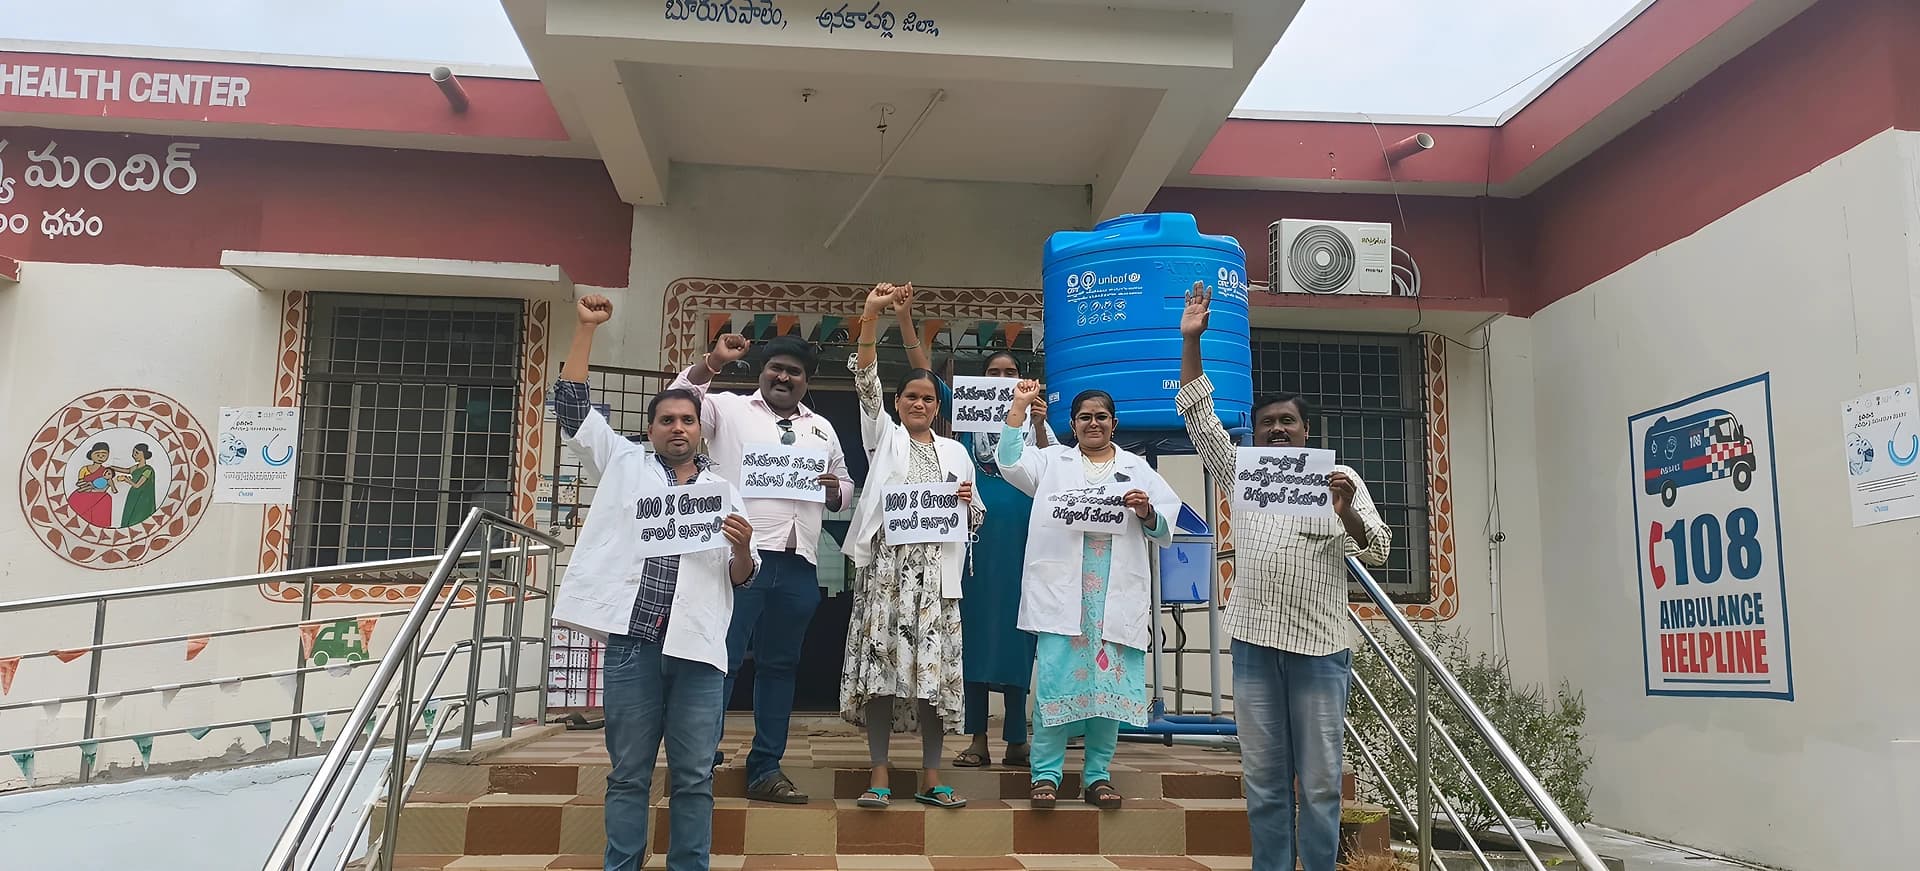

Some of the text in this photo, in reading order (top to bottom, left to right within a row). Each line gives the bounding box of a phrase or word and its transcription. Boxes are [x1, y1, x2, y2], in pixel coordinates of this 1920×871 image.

[815, 1, 896, 38] అనకాపల్లి
[0, 64, 251, 107] HEALTH CENTER
[24, 140, 200, 195] మందిర్
[41, 207, 104, 239] ధనం
[635, 493, 722, 519] 100 % Gross
[884, 490, 959, 512] 100 % Gross
[1664, 507, 1762, 585] 108
[1660, 592, 1765, 629] AMBULANCE
[1660, 630, 1769, 673] HELPLINE
